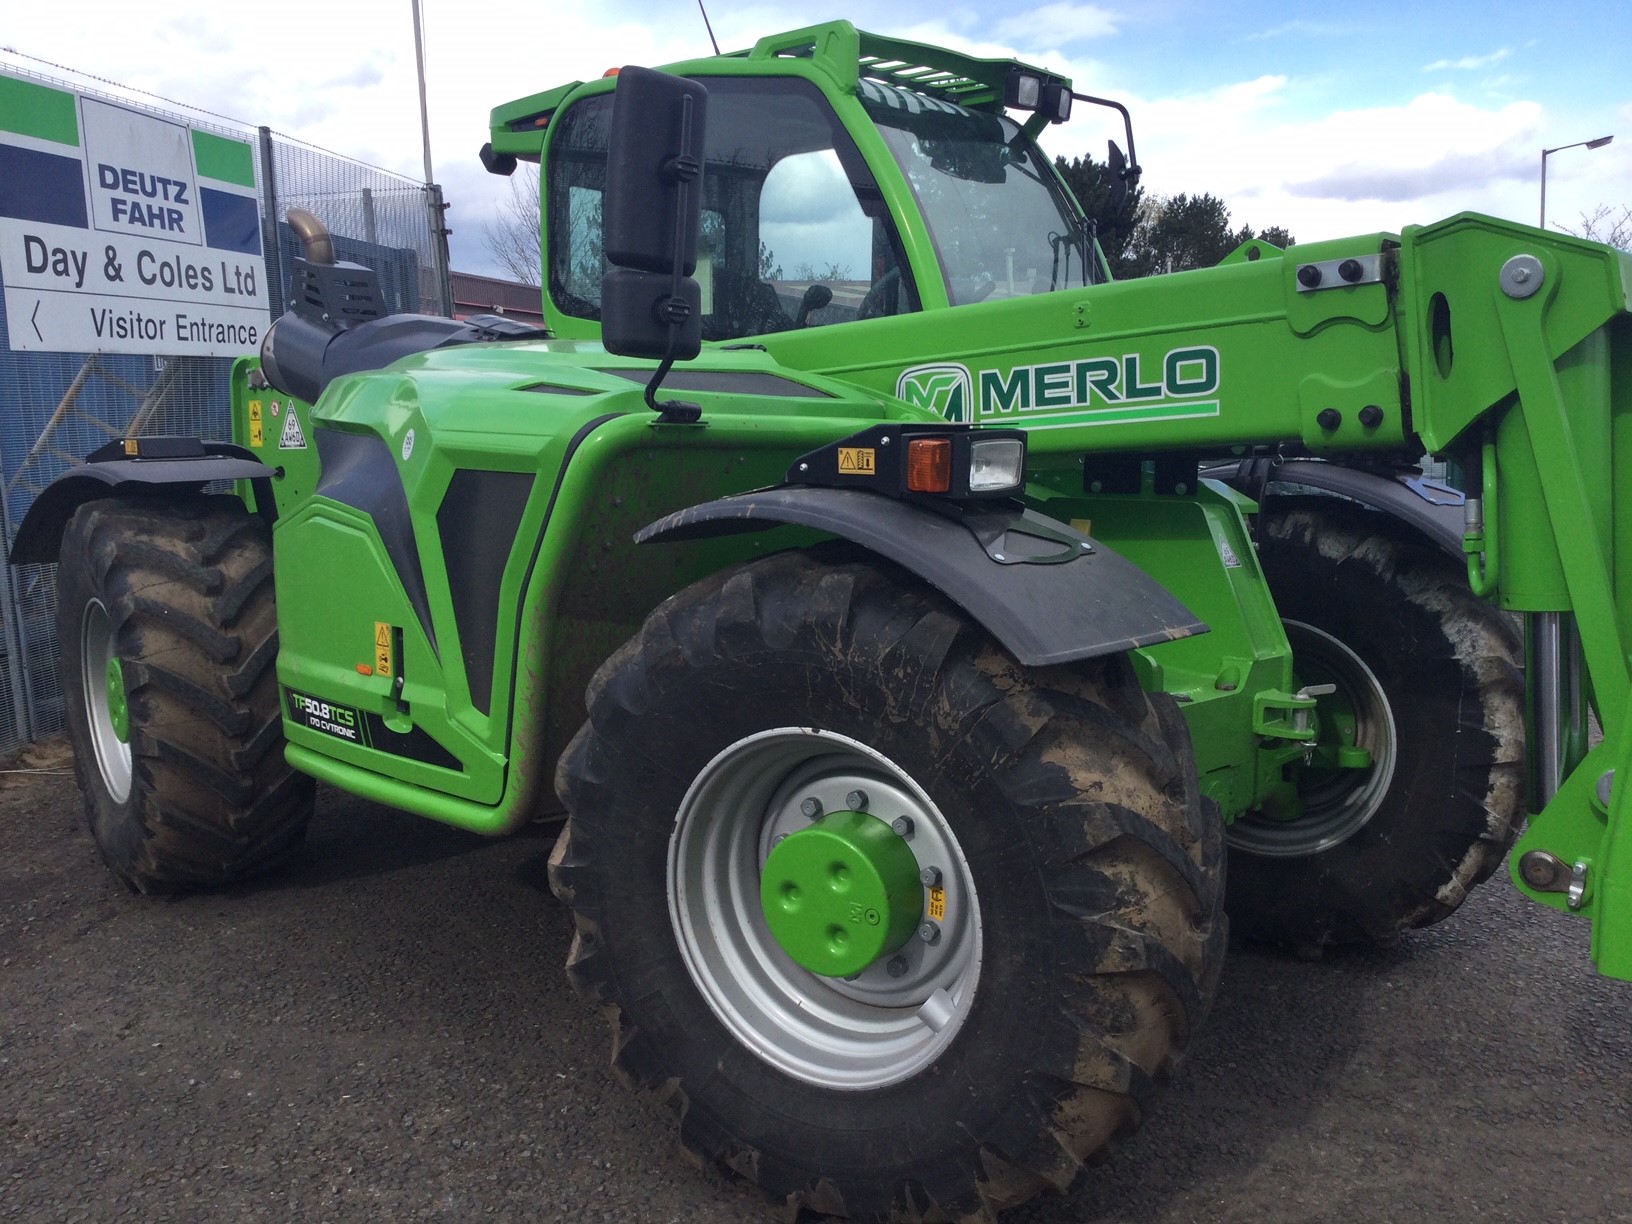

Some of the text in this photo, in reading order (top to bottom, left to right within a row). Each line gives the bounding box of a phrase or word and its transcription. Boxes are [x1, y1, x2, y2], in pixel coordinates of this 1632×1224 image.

[98, 163, 189, 205] DEUTZ
[110, 197, 185, 233] FAHR
[24, 234, 257, 296] Day & Coles Ltd
[90, 308, 258, 345] Visitor Entrance
[979, 345, 1220, 415] MERLO
